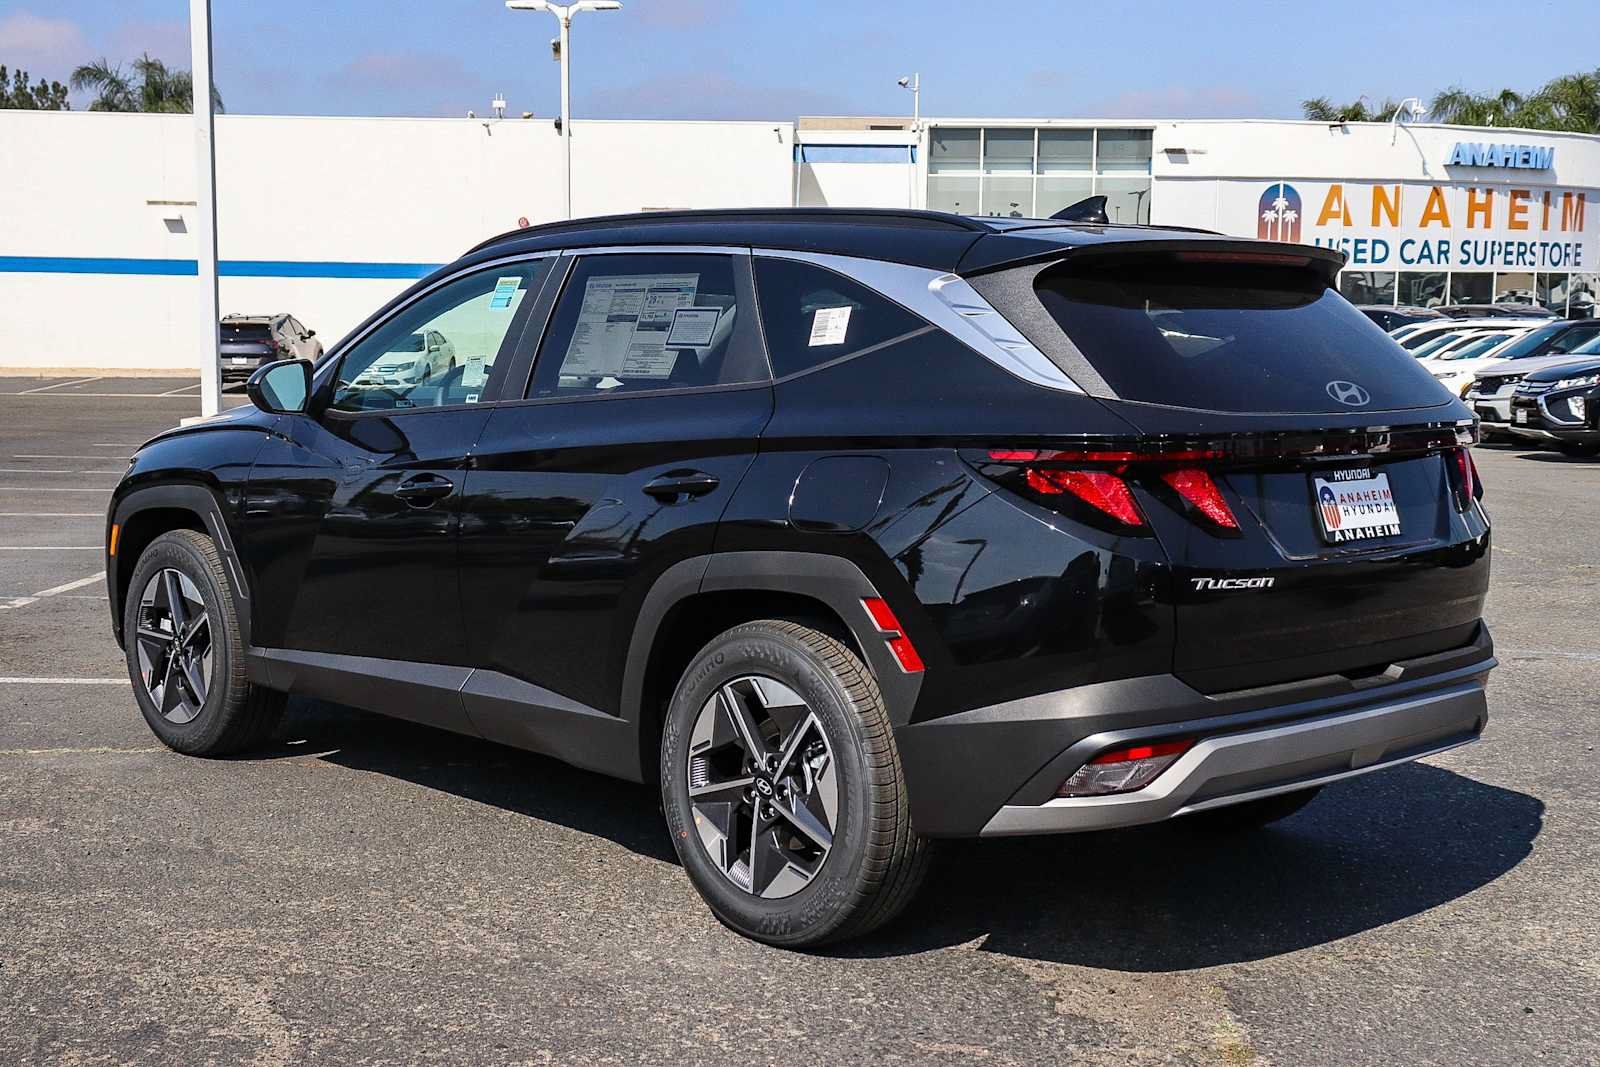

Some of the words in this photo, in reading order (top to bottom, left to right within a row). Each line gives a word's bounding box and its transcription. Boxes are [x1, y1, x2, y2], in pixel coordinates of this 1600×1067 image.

[1449, 142, 1554, 169] ANAHEIM
[1316, 184, 1585, 232] ANAHEIM
[1400, 239, 1450, 265] CAR
[1460, 239, 1582, 267] SUPERSTORE
[1333, 468, 1371, 481] HYUNDAI
[1340, 489, 1392, 504] ANAHEIM
[1334, 524, 1401, 542] ANAHEIM
[1190, 577, 1275, 591] Tucson
